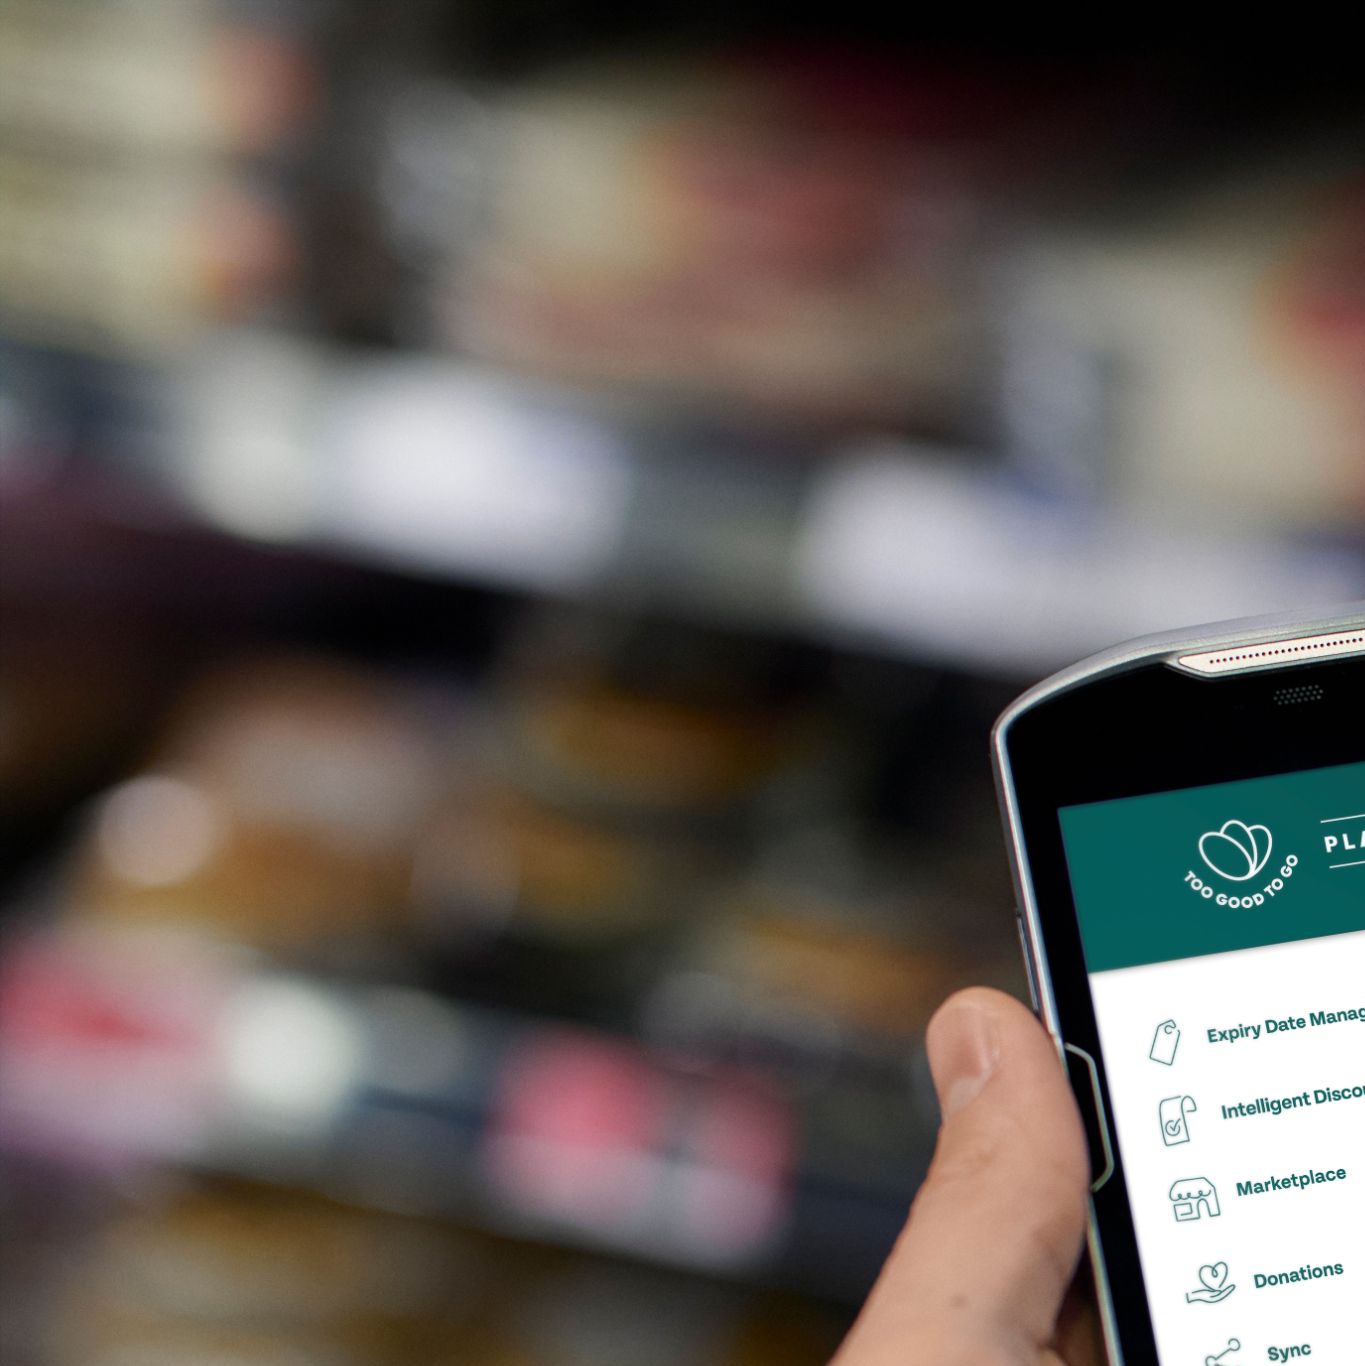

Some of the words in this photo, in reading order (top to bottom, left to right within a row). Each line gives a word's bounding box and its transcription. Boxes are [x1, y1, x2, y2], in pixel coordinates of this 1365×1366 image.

[1184, 870, 1214, 899] TOO
[1215, 892, 1265, 909] GOOD
[1263, 877, 1284, 897] TO
[1279, 853, 1299, 878] GO
[1206, 1023, 1262, 1044] Expiry
[1264, 1016, 1307, 1034] Date
[1221, 1091, 1312, 1120] Intelligent
[1235, 1168, 1347, 1197] Marketplace
[1253, 1263, 1345, 1289] Donations
[1267, 1343, 1312, 1364] Sync
